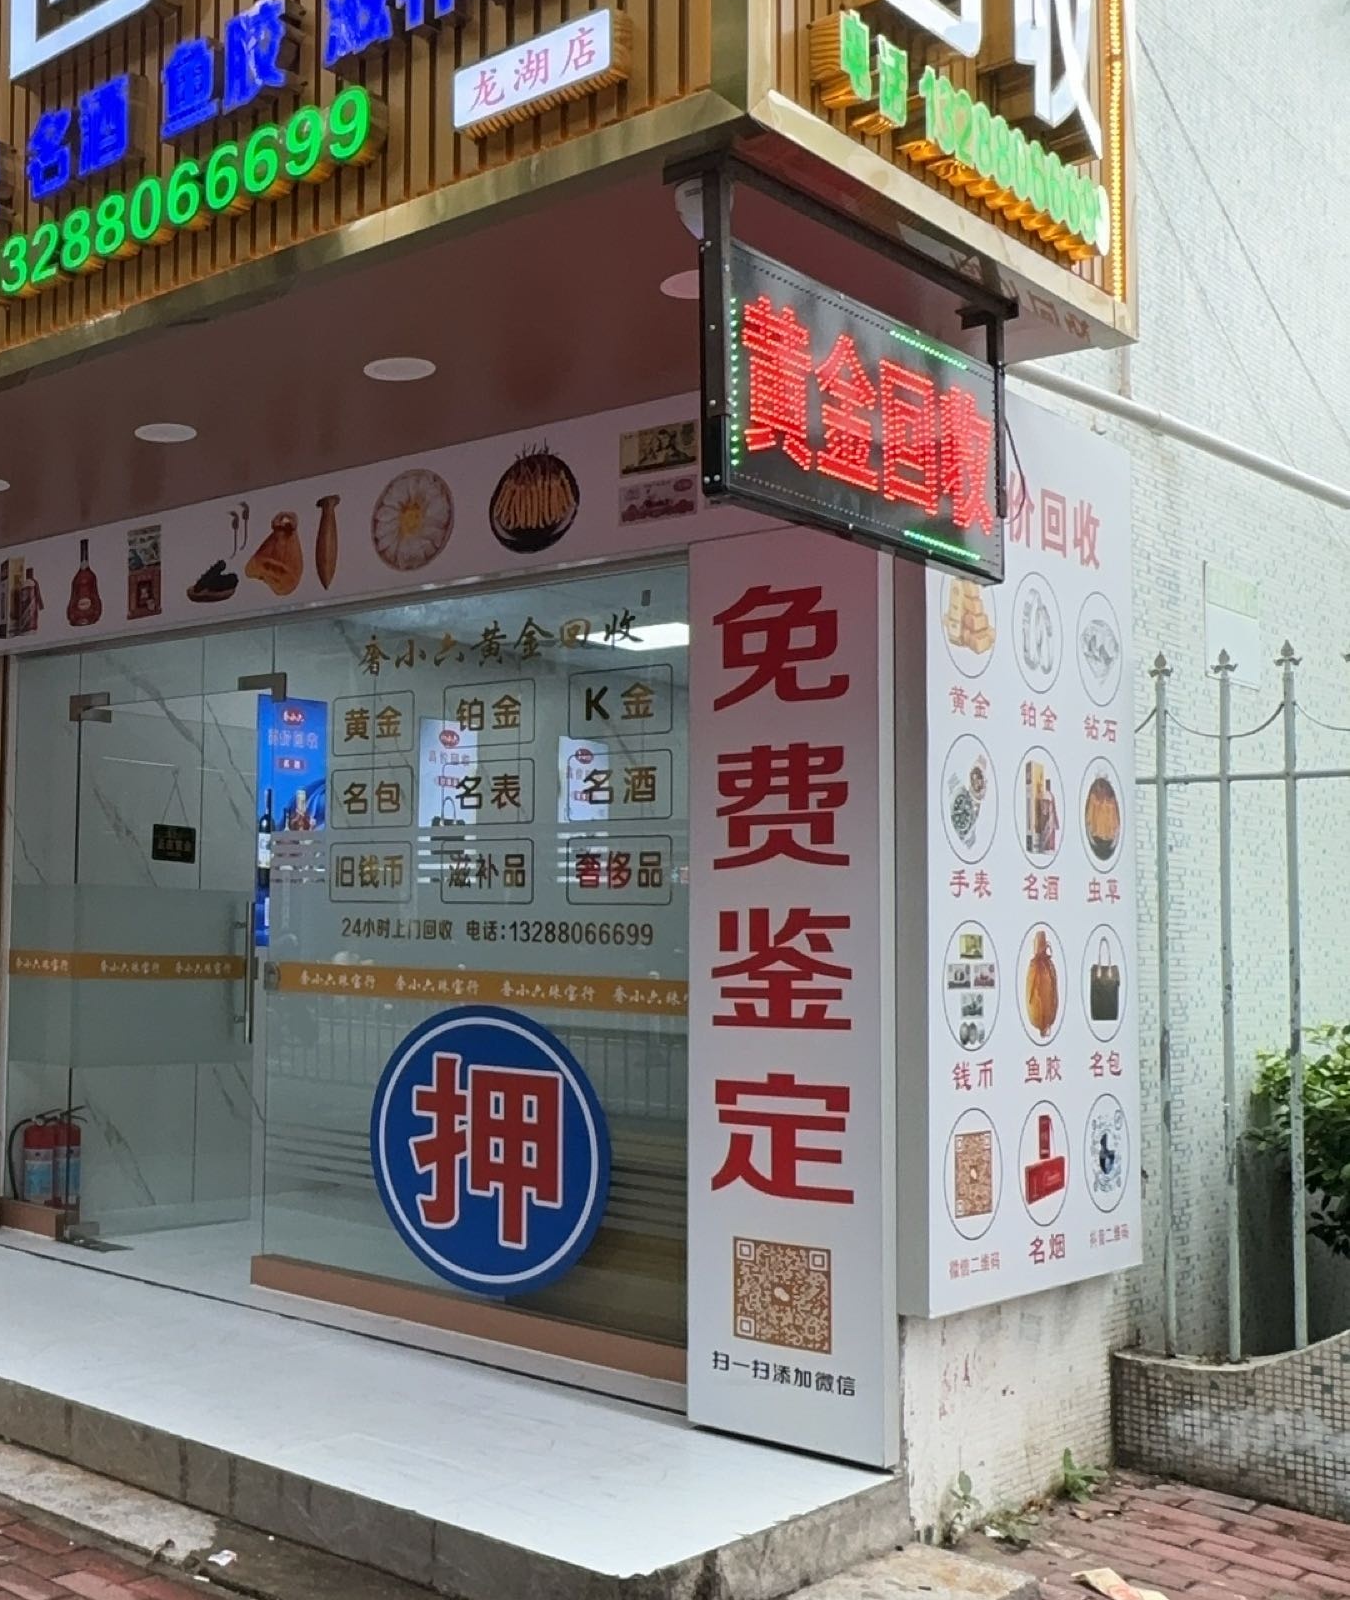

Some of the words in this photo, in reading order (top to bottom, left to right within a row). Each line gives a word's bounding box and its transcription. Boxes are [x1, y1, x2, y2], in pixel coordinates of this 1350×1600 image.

[467, 27, 597, 111] 龙湖店
[27, 74, 129, 199] 名酒
[457, 694, 522, 731] 铂金
[585, 681, 655, 721] K金
[949, 686, 992, 720] 黄金
[1020, 701, 1058, 732] 铂金
[344, 705, 403, 742] 黄金
[1083, 714, 1118, 743] 钻石
[343, 780, 402, 815] 名包
[456, 773, 521, 810] 名表
[583, 766, 657, 805] 名酒
[335, 854, 404, 890] 旧钱币
[576, 850, 663, 889] 奢侈品
[949, 869, 992, 900] 手表
[710, 584, 855, 1204] 免费鉴定
[1022, 874, 1060, 902] 名酒
[1086, 877, 1121, 904] 虫草
[341, 917, 454, 941] 24小时上门回收
[952, 1058, 995, 1092] 钱币
[1025, 1055, 1062, 1084] 鱼胶
[1089, 1049, 1123, 1078] 名包
[410, 1052, 565, 1250] 押
[1029, 1232, 1067, 1265] 名烟
[711, 1349, 857, 1396] 扫一扫添加微信
